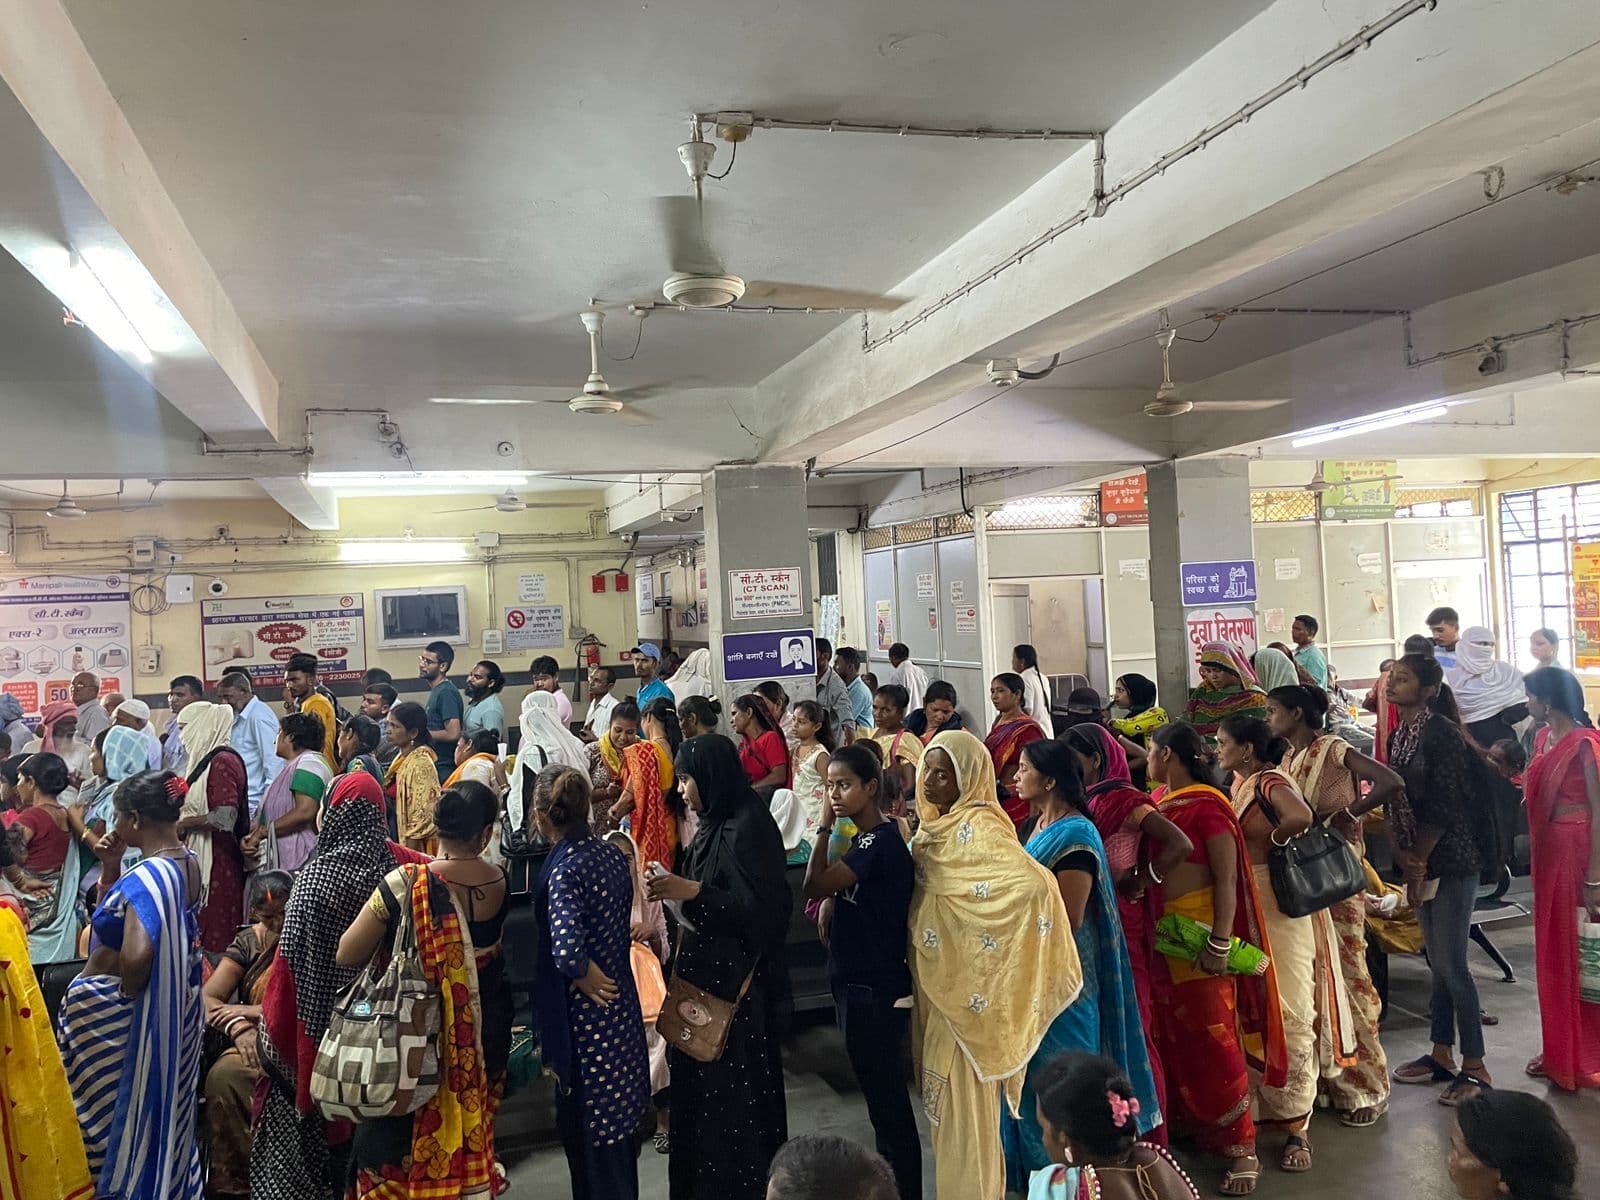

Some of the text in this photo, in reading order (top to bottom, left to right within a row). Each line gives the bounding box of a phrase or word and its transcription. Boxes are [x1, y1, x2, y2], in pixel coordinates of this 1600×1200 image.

[1185, 573, 1219, 584] परिसर को
[760, 584, 789, 592] SCAN)
[1186, 586, 1204, 594] स्वच्छ
[1187, 620, 1212, 648] दवा
[1213, 612, 1255, 645] वितरण
